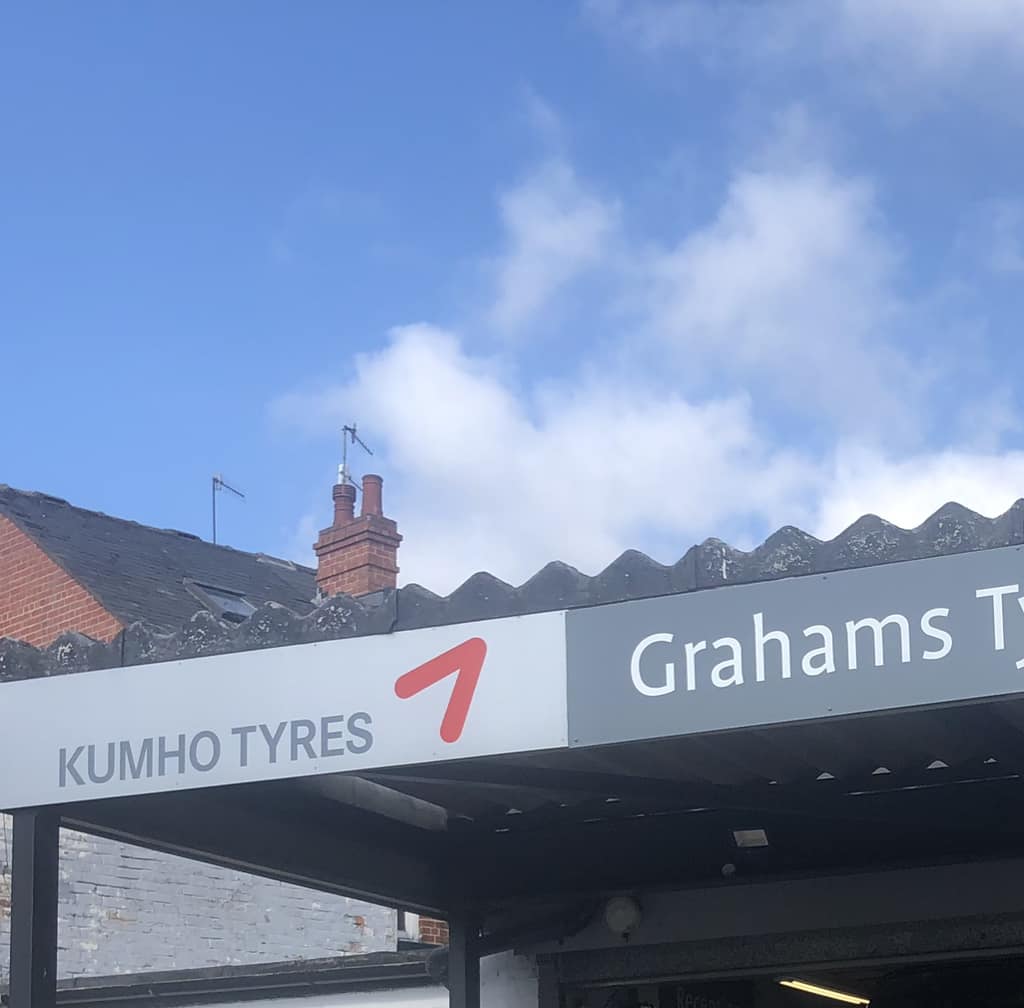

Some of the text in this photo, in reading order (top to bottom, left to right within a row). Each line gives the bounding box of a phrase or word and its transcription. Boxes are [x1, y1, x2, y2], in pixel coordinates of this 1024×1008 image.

[629, 607, 953, 697] Grahams
[58, 711, 374, 787] KUMHO TYRES
